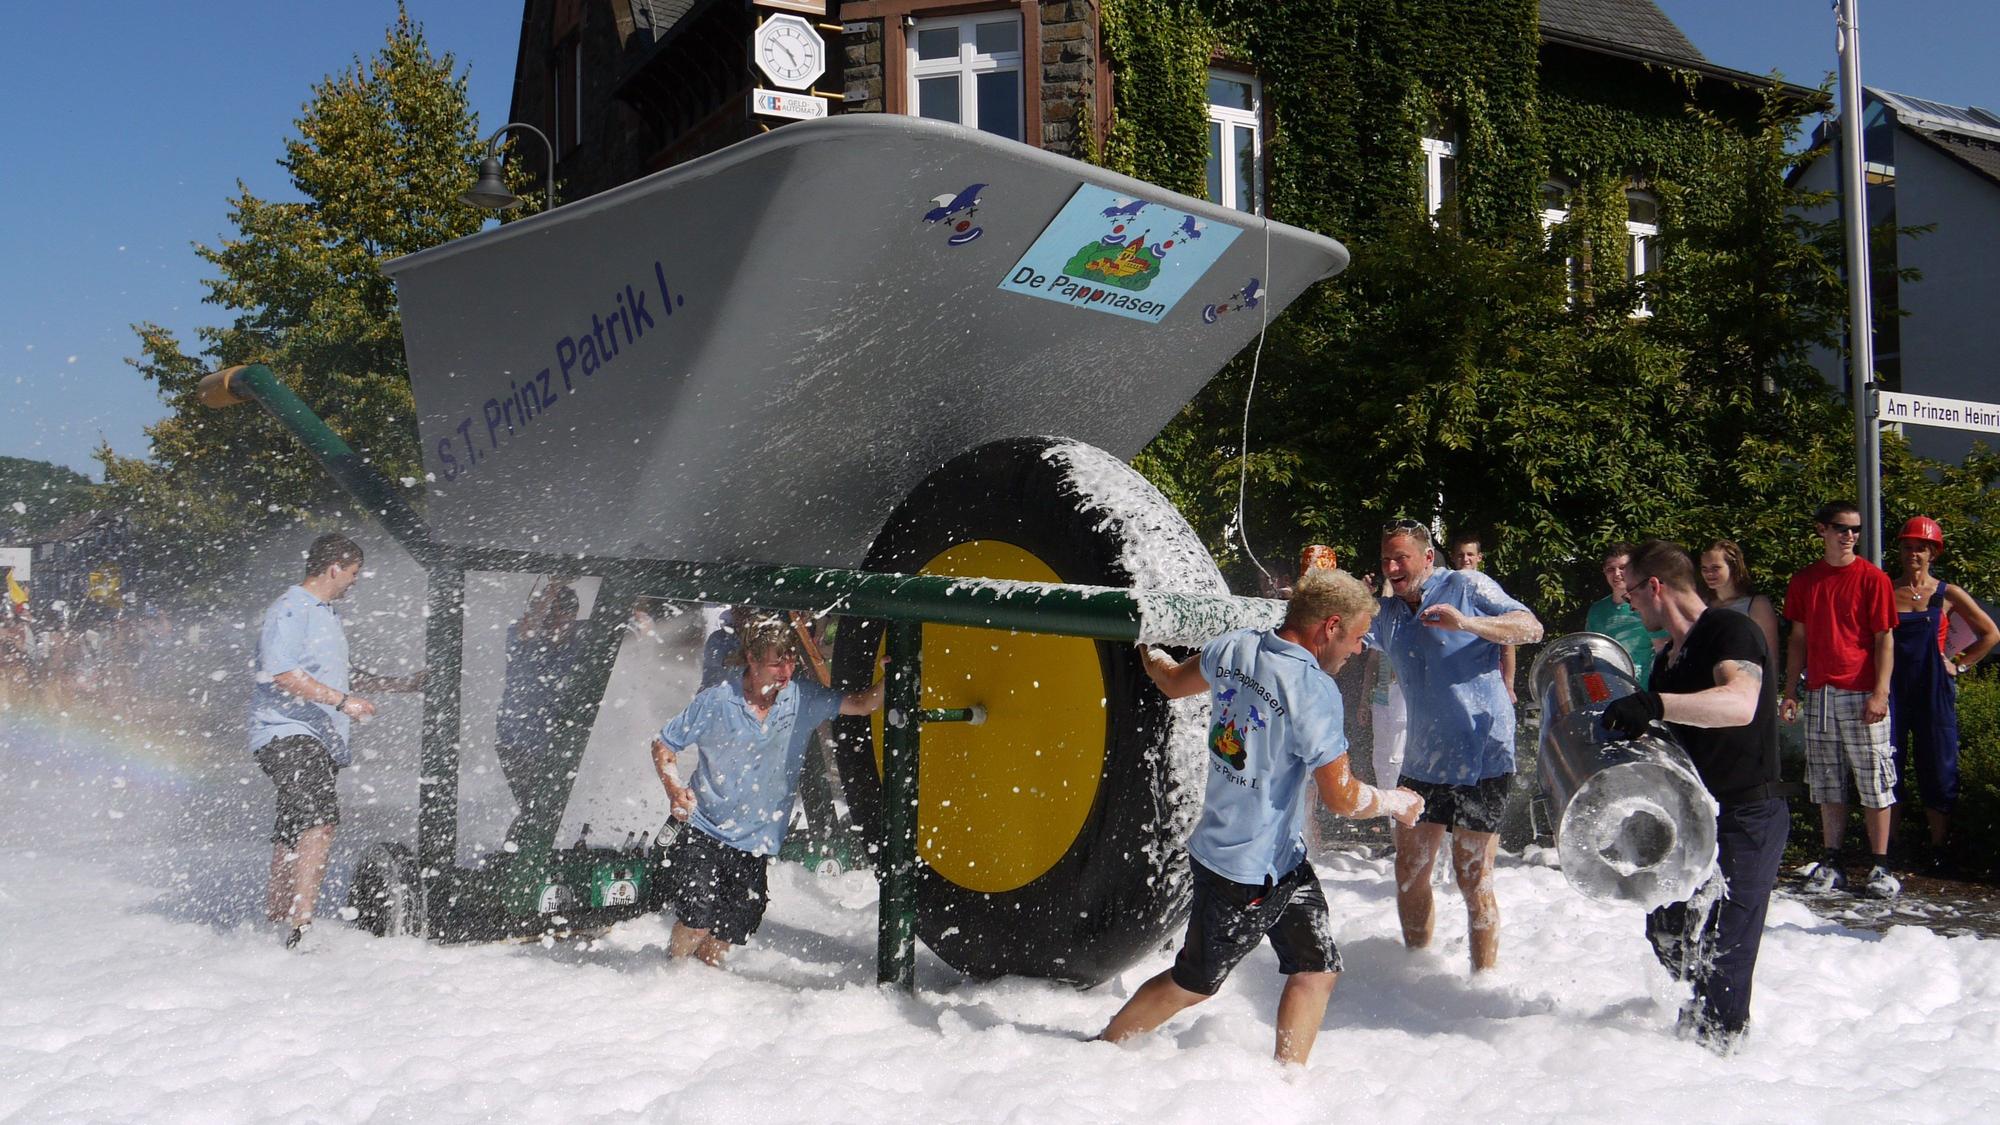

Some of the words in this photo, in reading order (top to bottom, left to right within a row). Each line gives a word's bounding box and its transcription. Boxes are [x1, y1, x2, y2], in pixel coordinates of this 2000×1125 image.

[782, 105, 815, 114] AUTOMAT
[1011, 266, 1046, 288] De
[1047, 275, 1166, 317] Pappnasen
[483, 367, 558, 449] Prinz
[555, 284, 655, 392] Patrik
[1887, 398, 1908, 416] Am
[1913, 400, 1959, 422] Prinzen
[1215, 666, 1231, 678] De
[1233, 668, 1286, 717] Pappnasen
